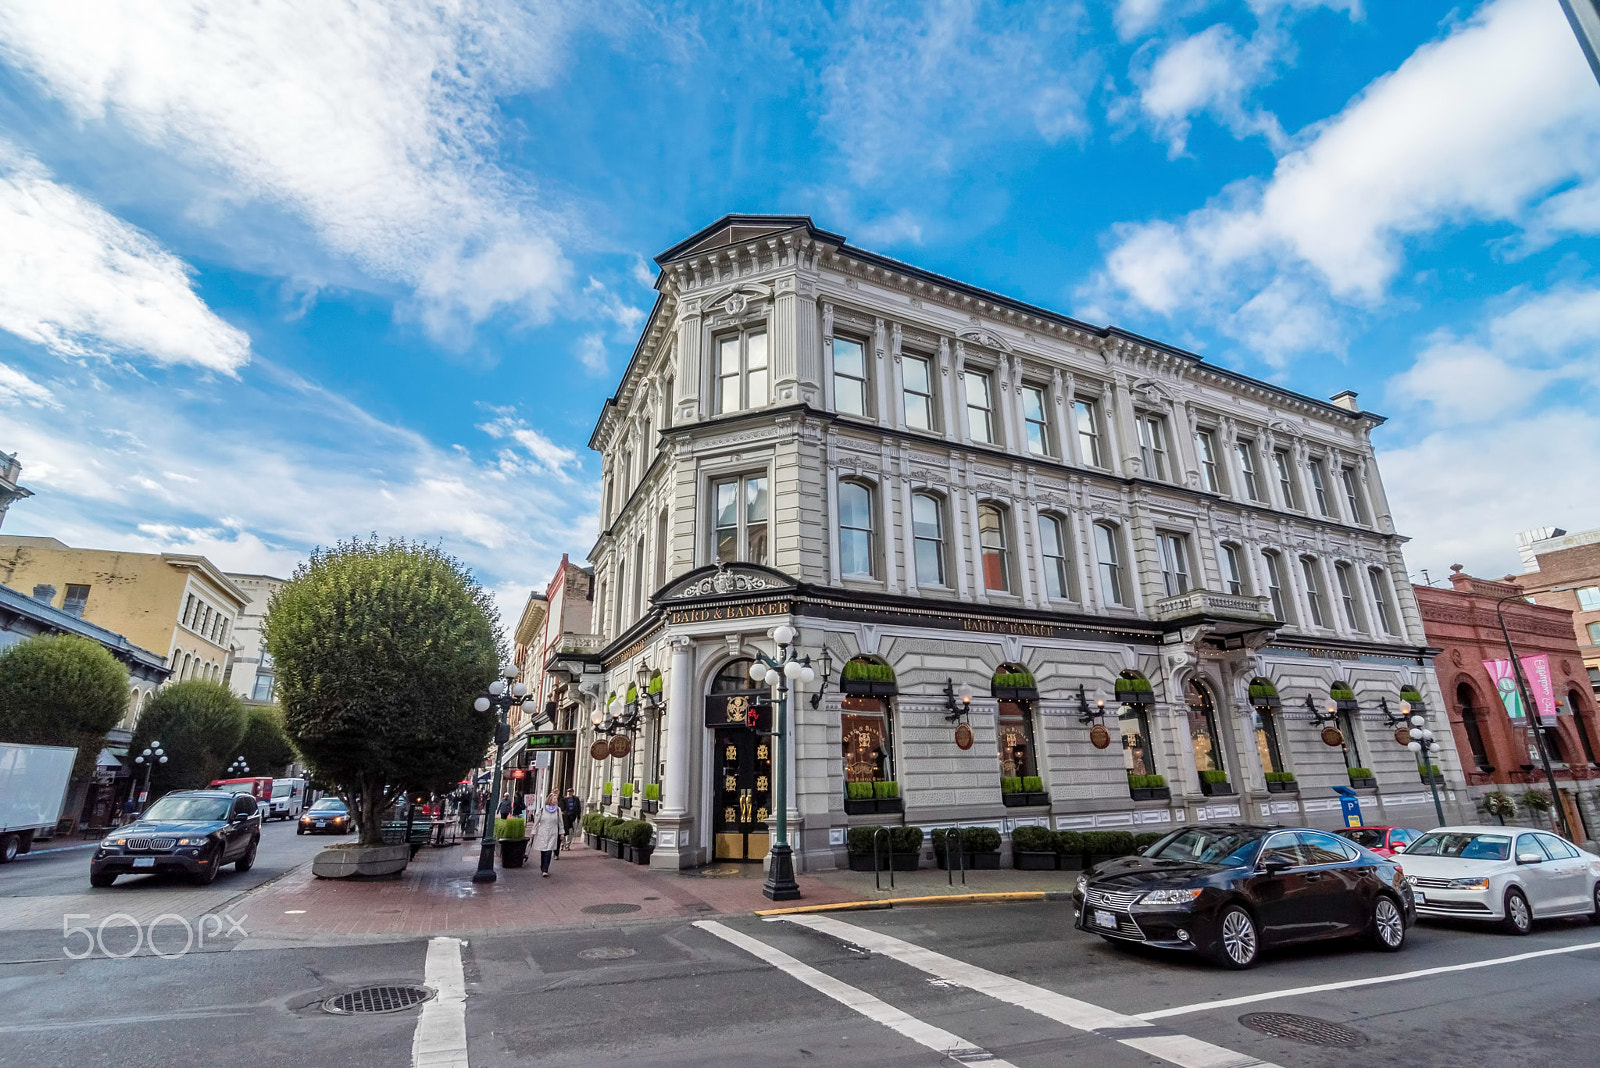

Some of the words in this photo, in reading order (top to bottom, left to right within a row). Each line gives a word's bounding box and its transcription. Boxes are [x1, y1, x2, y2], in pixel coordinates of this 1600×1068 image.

[672, 610, 710, 624] BARD
[713, 608, 723, 620] &
[726, 602, 789, 619] BANKER
[963, 620, 995, 632] BARD
[998, 624, 1006, 632] &
[1010, 623, 1054, 637] BANKER
[1347, 802, 1354, 811] P
